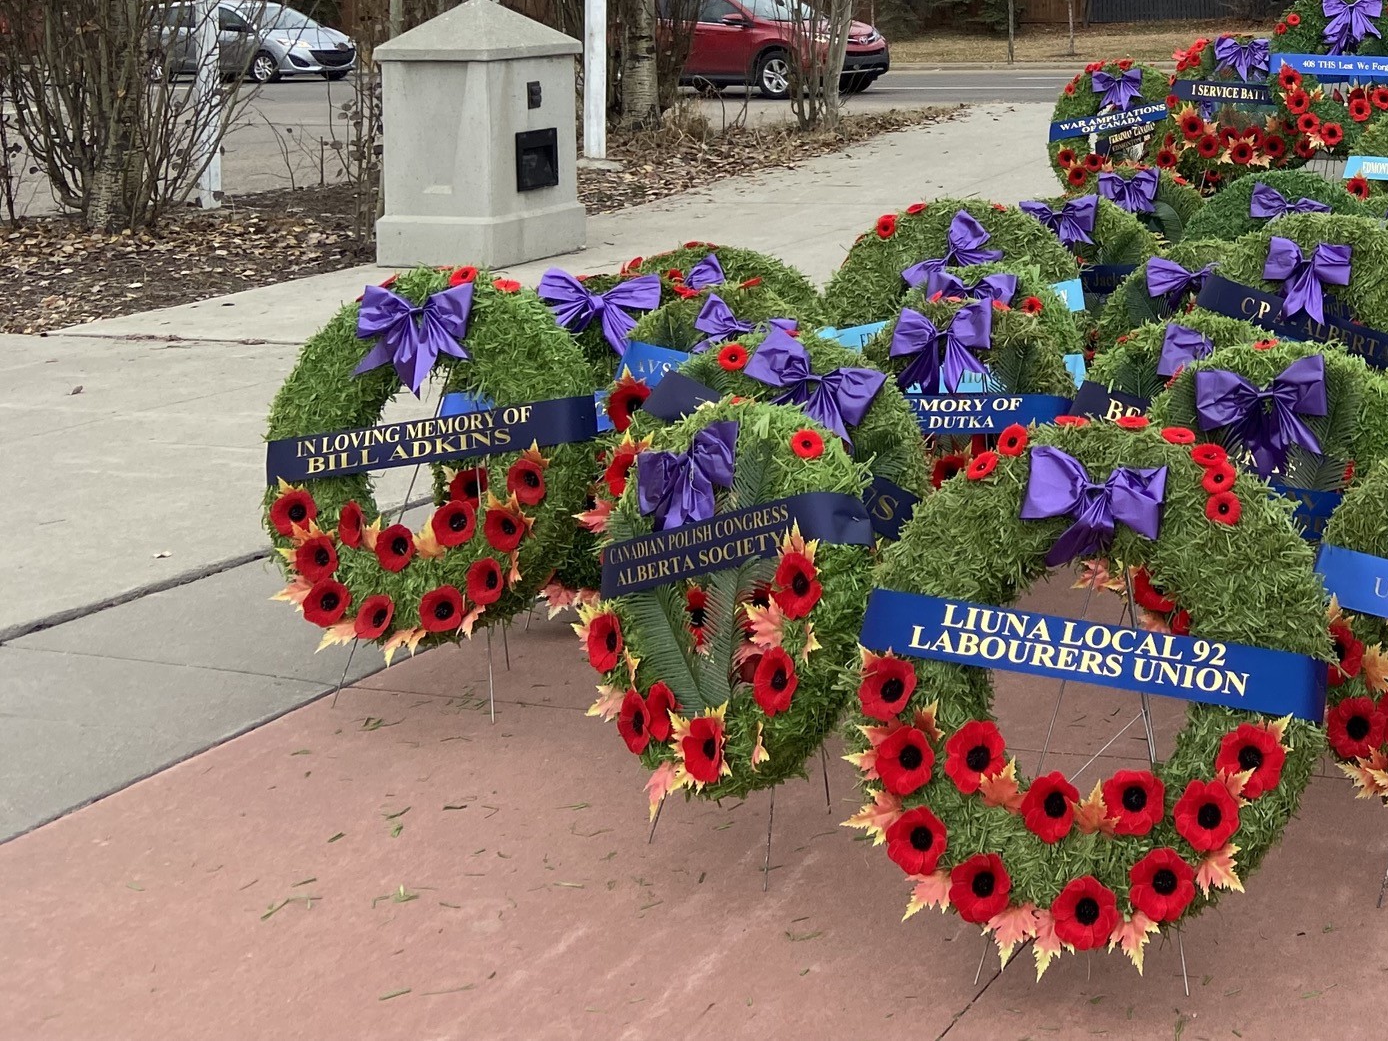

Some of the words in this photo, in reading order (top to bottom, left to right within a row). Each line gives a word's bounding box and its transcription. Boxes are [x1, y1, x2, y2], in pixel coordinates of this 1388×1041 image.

[1302, 60, 1316, 68] 408
[1317, 60, 1336, 69] THS
[1338, 61, 1354, 70] Lest
[1357, 62, 1370, 71] We
[1197, 85, 1239, 99] SERVICE
[1060, 120, 1088, 131] WAR
[1089, 103, 1166, 126] AMPUTATIONS
[1081, 123, 1097, 134] OF
[1098, 115, 1143, 130] CANADA
[928, 416, 994, 429] DUTKA
[992, 397, 1023, 411] OF
[296, 438, 317, 458] IN
[322, 426, 400, 455] LOVING
[405, 411, 497, 441] MEMORY
[503, 405, 533, 425] OF
[306, 449, 379, 475] BILL
[387, 428, 512, 461] ADKINS
[609, 539, 666, 565] CANADIAN
[668, 525, 713, 551] POLISH
[715, 504, 789, 536] CONGRESS
[616, 554, 696, 588] ALBERTA
[699, 528, 787, 568] SOCIETY
[941, 603, 1051, 642] LIUNA
[1060, 620, 1184, 661] LOCAL
[1192, 640, 1228, 667] 92
[909, 625, 1123, 678] LABOURERS
[1132, 658, 1251, 697] UNION
